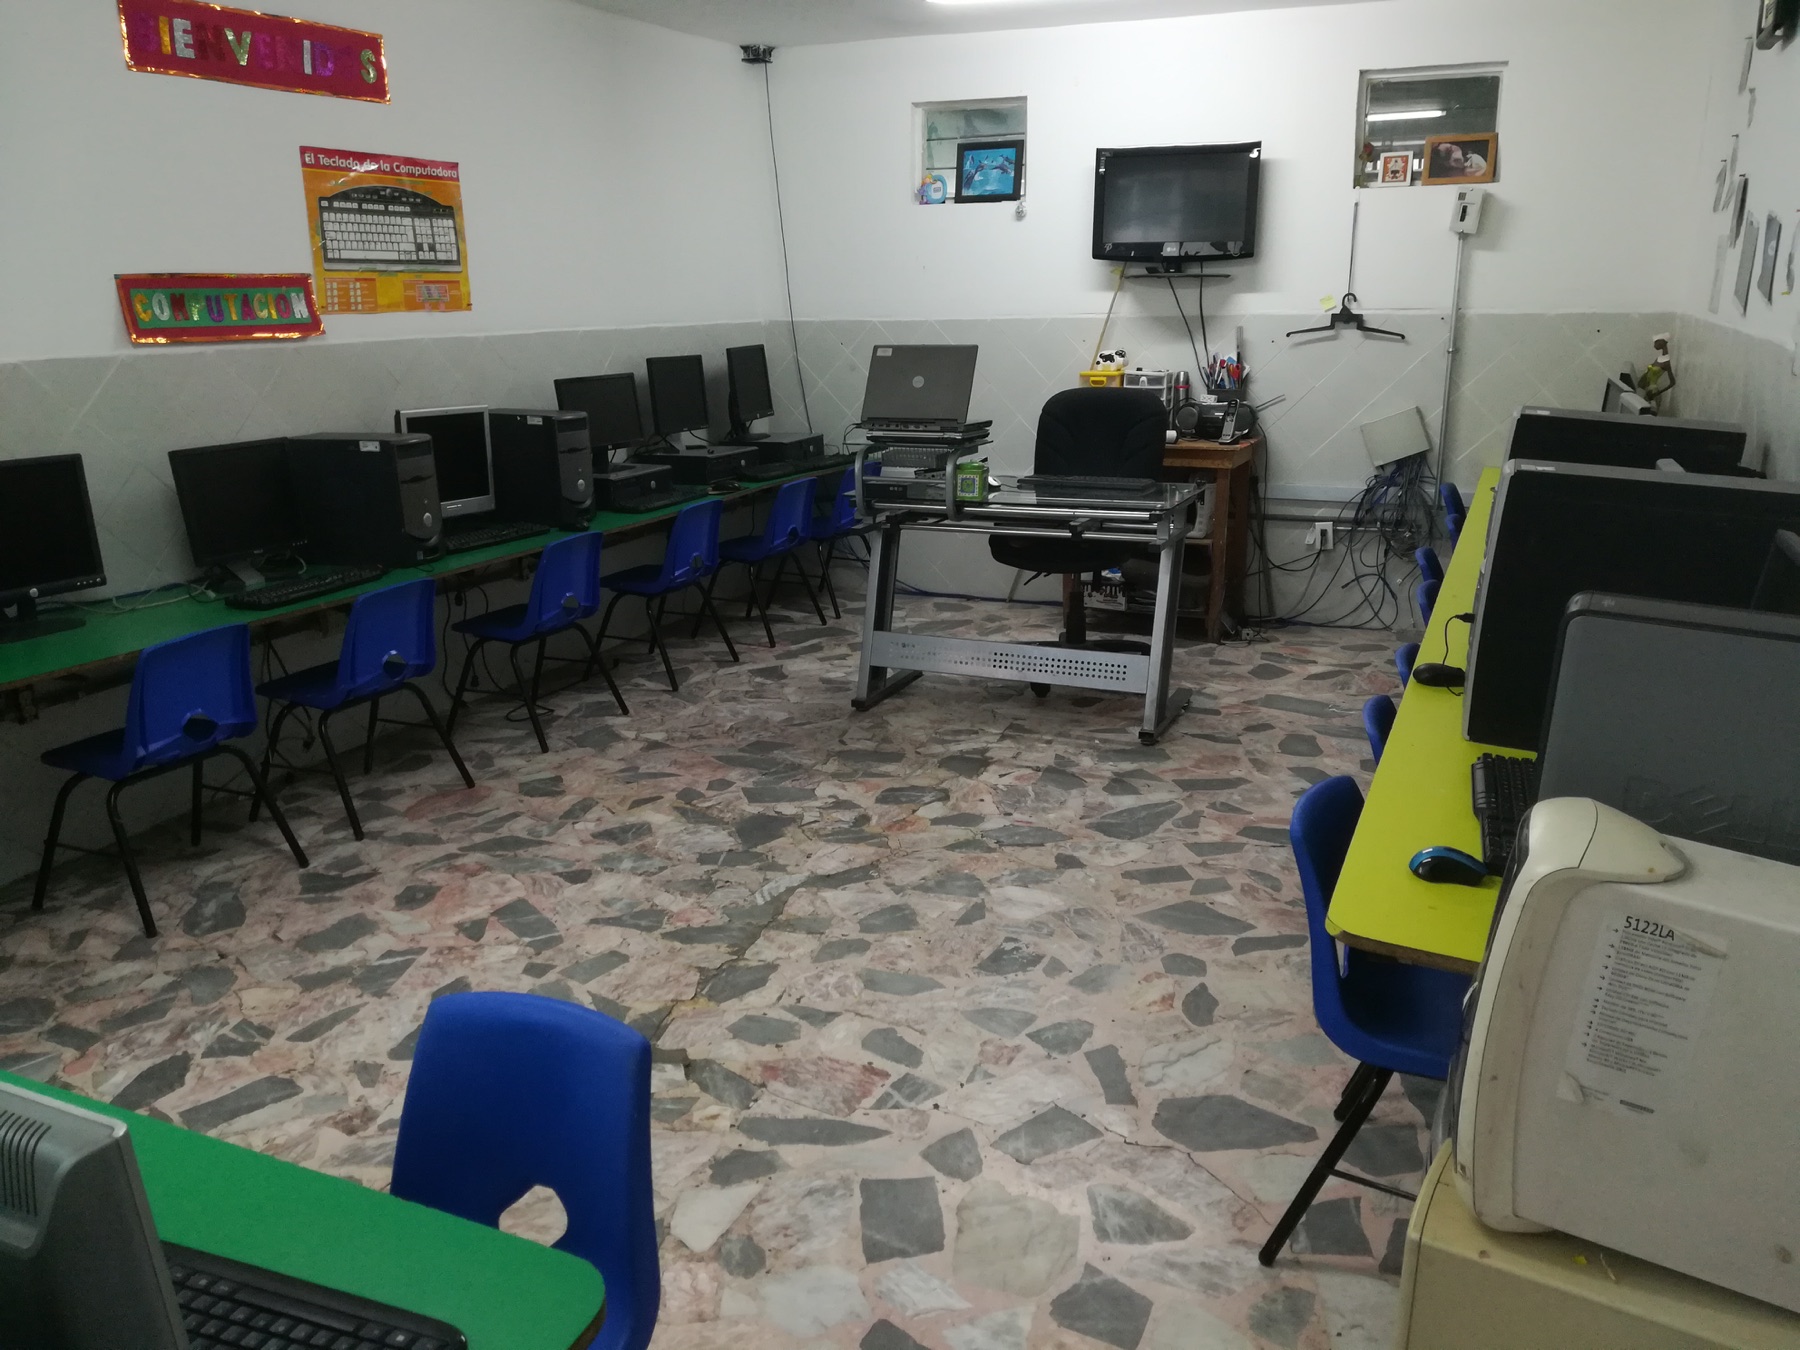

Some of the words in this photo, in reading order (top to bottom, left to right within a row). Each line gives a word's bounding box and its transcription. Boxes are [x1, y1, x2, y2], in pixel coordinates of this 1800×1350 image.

[132, 11, 378, 84] BIENVENIDS
[304, 152, 315, 165] El
[317, 154, 360, 169] Teclado
[380, 160, 391, 172] la
[393, 162, 458, 178] Computadora
[1623, 915, 1675, 941] 5122LA
